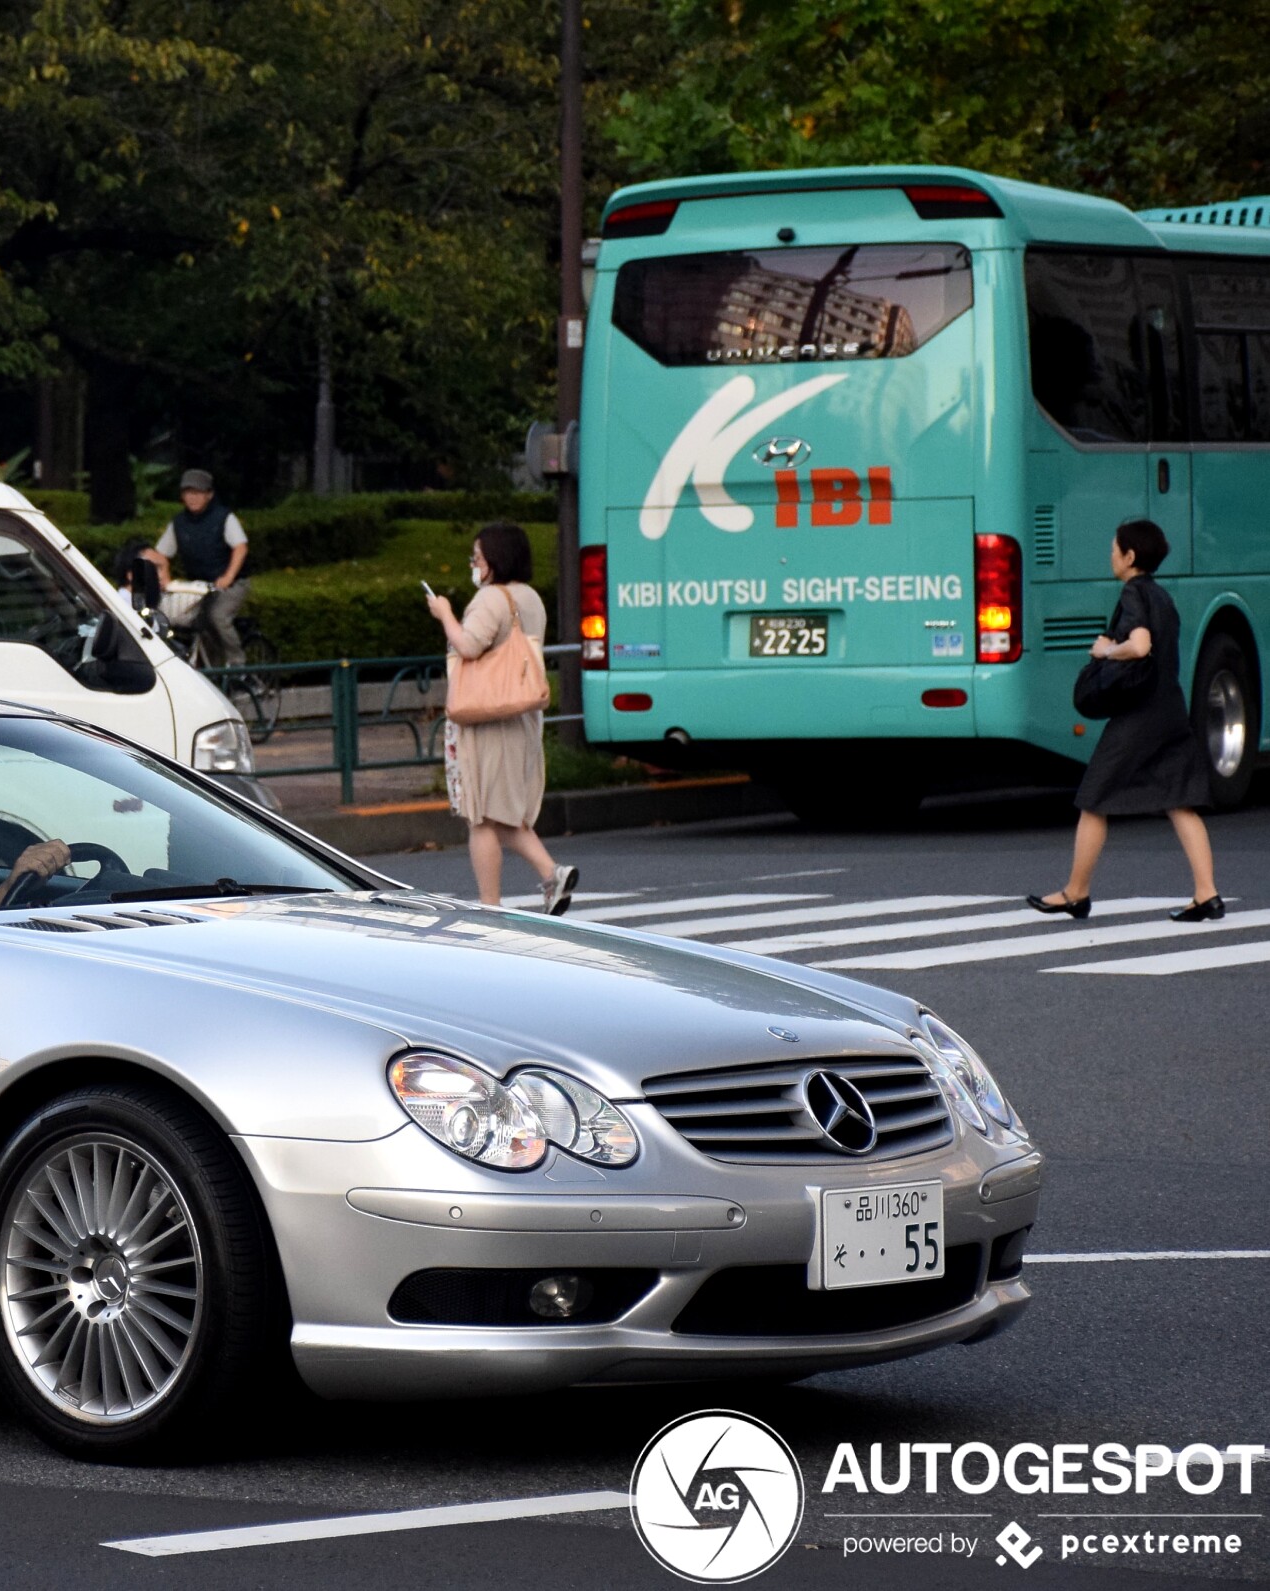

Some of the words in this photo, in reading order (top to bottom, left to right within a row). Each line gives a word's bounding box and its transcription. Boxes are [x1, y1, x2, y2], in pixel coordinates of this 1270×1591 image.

[618, 582, 662, 607] KIBI
[668, 580, 767, 606] KOUTSU
[783, 574, 962, 604] SIGHT-SEEING
